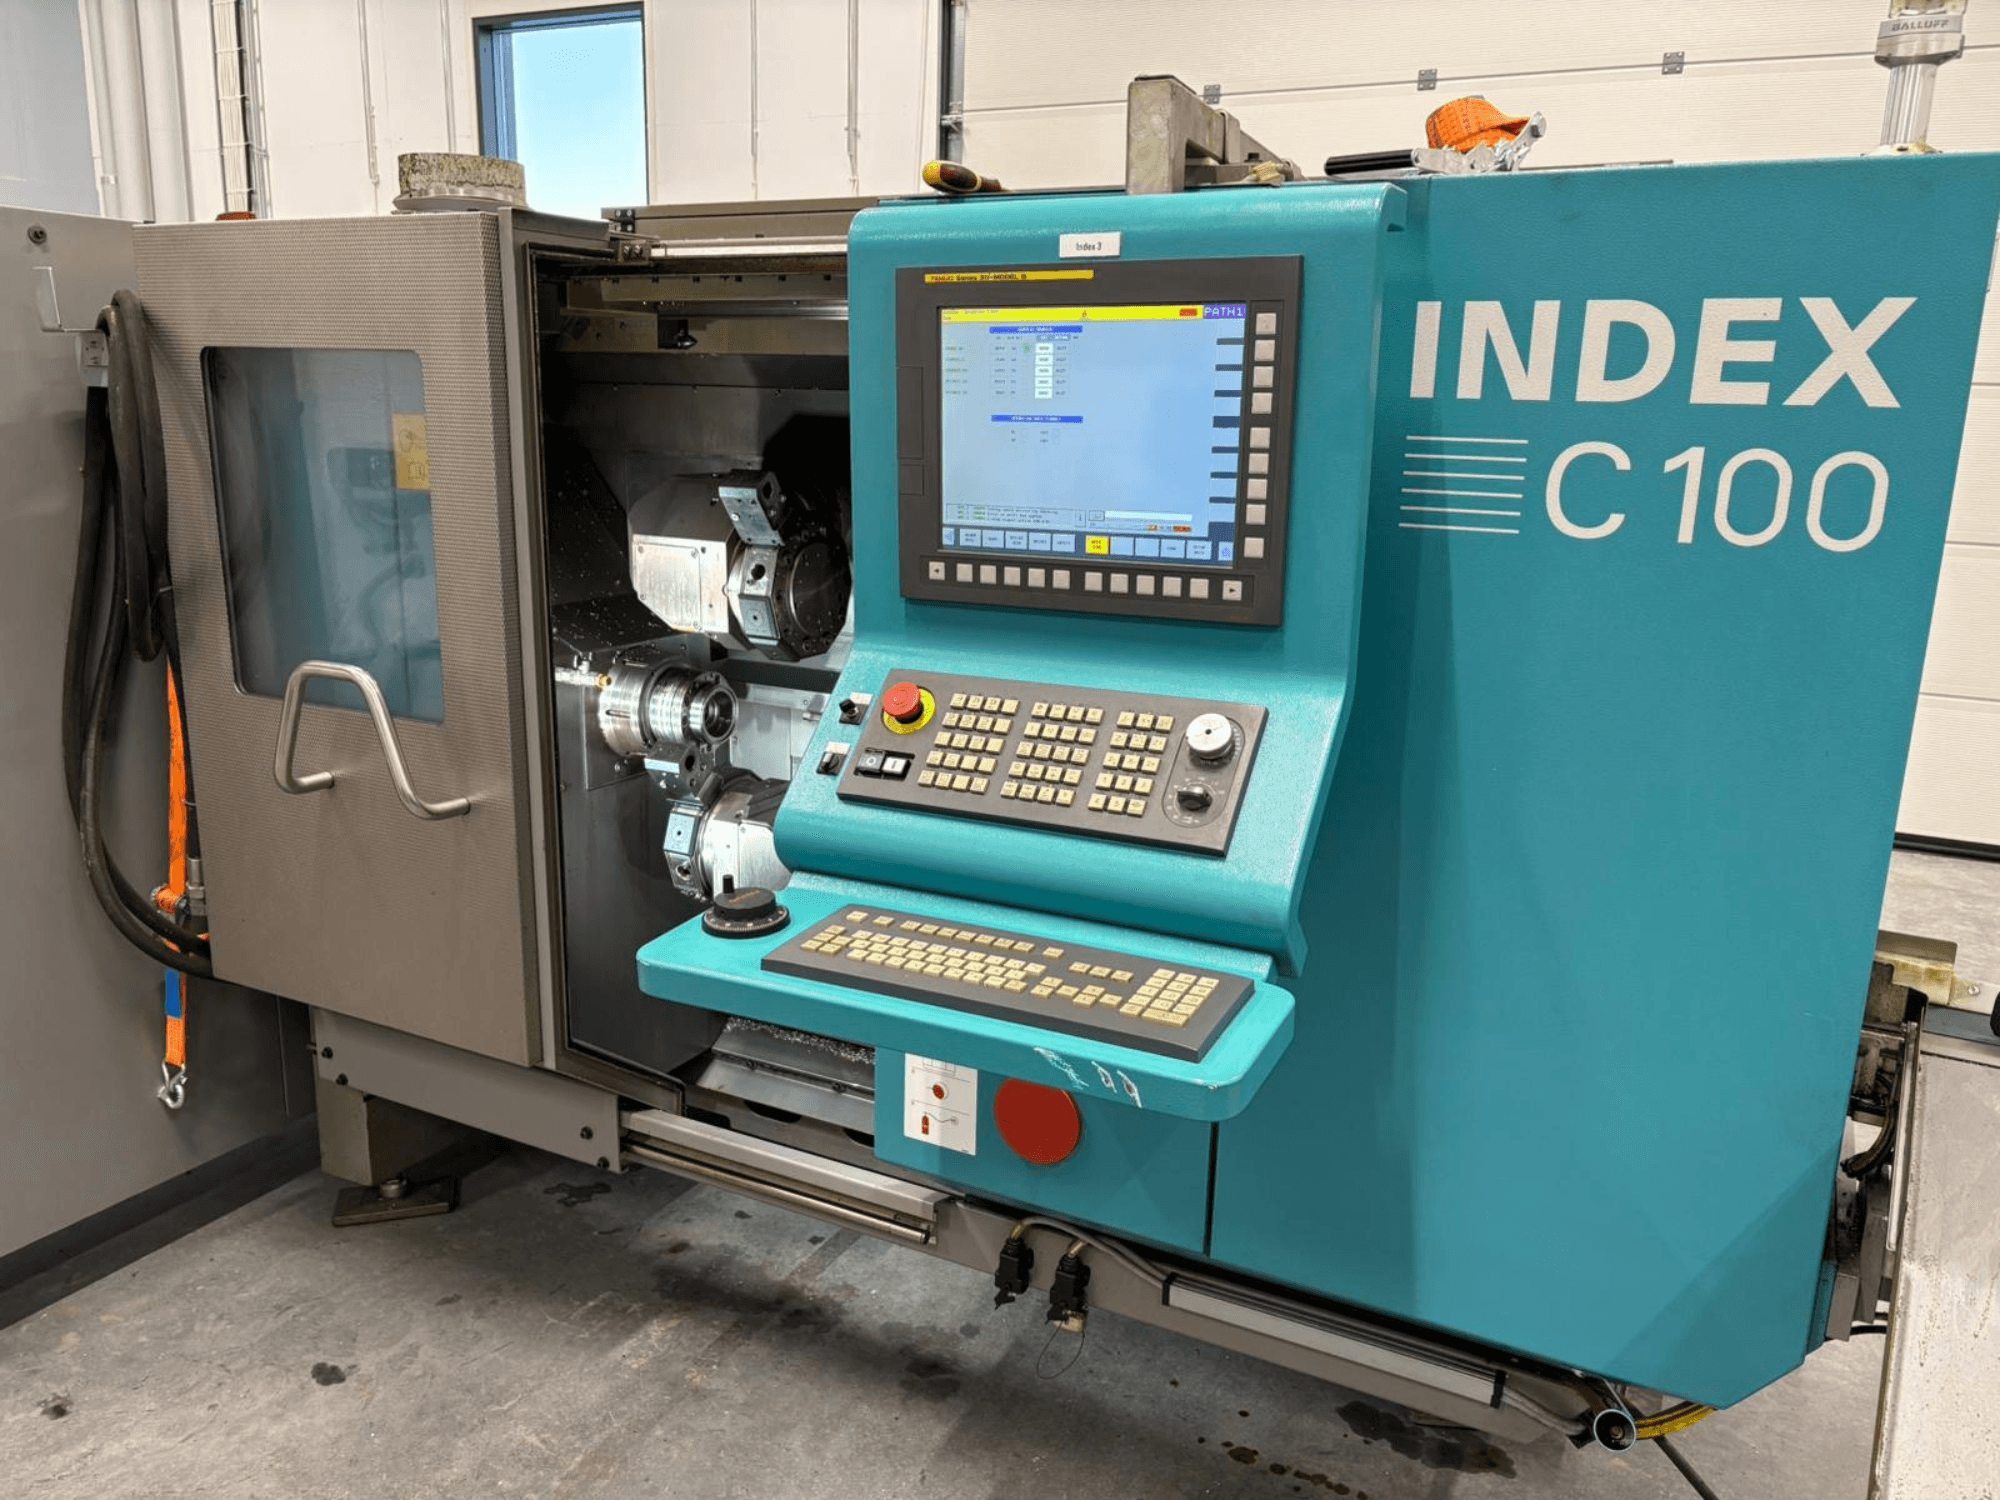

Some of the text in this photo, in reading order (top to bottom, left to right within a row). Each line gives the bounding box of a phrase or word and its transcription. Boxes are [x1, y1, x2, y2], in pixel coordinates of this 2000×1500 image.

[1891, 19, 1949, 32] BALLUFF
[1075, 241, 1102, 251] Index 3
[1205, 307, 1243, 316] PATH1
[1409, 296, 1918, 409] INDEX
[1545, 440, 1889, 553] C 100
